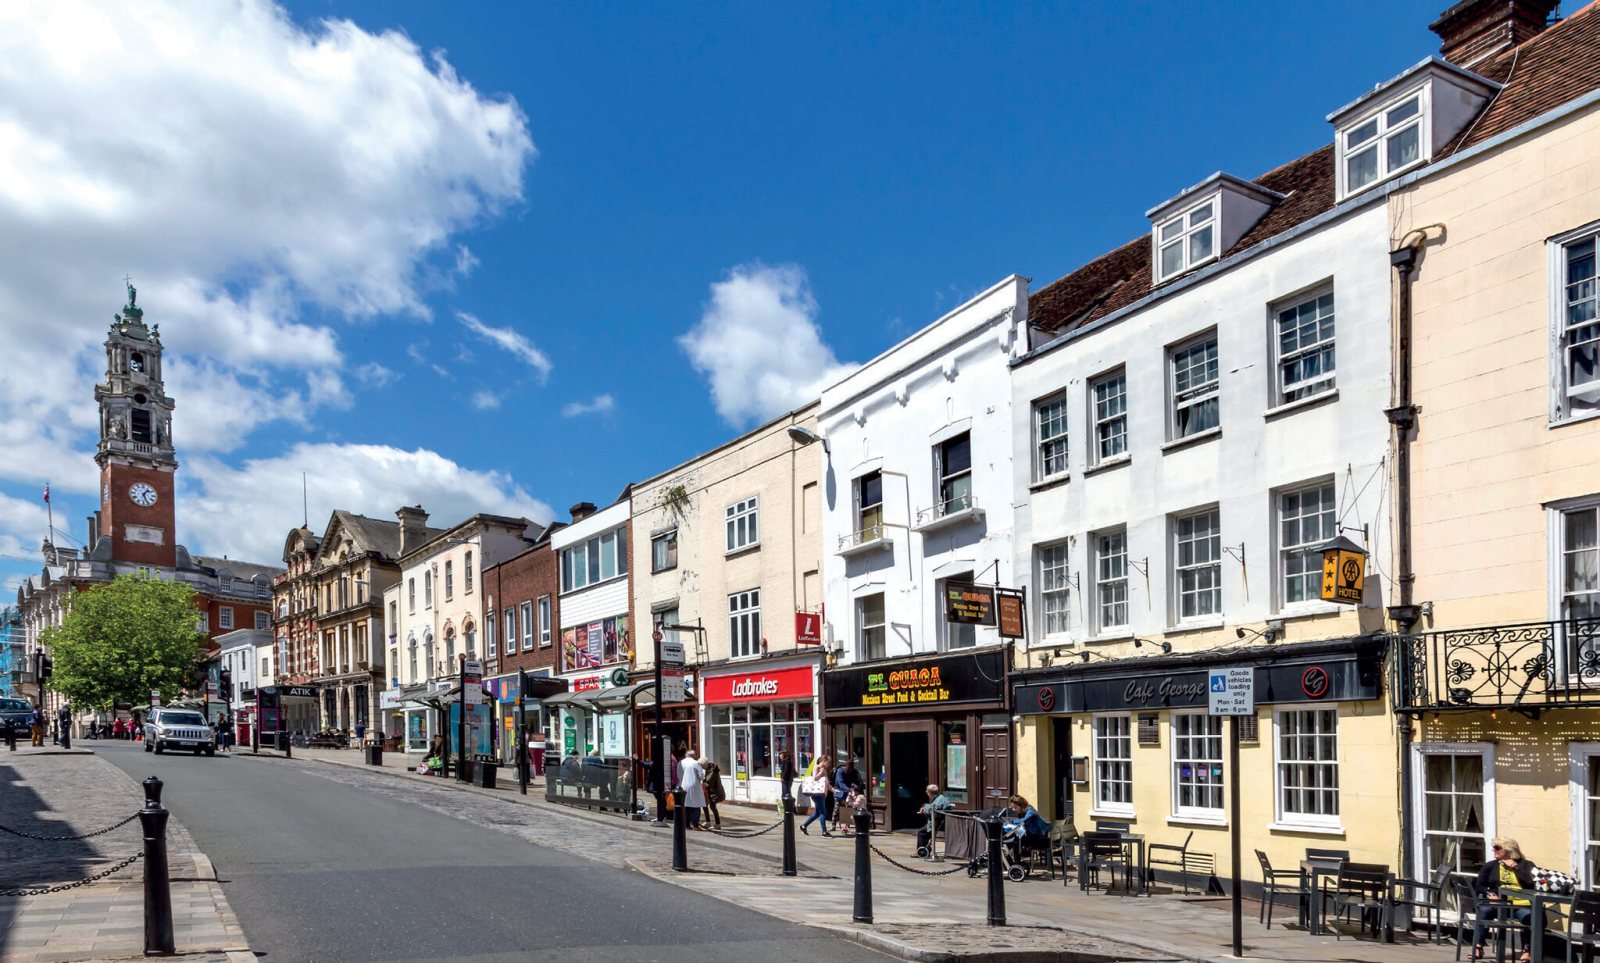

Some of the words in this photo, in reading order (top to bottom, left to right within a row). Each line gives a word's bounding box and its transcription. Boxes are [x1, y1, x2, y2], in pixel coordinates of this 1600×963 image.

[1339, 588, 1361, 600] HOTEL
[804, 617, 814, 635] L
[579, 678, 600, 690] SPAR
[732, 677, 778, 698] Ladbrokes
[868, 673, 888, 692] EL
[888, 666, 942, 690] GUACA
[290, 687, 312, 696] ATIK
[862, 693, 881, 706] Mexican
[881, 692, 896, 705] Street
[897, 691, 909, 704] Food
[910, 691, 916, 702] &
[917, 689, 938, 702] Cocktail
[939, 688, 950, 701] Bar
[1123, 680, 1154, 704] Cafe
[1159, 676, 1206, 703] George
